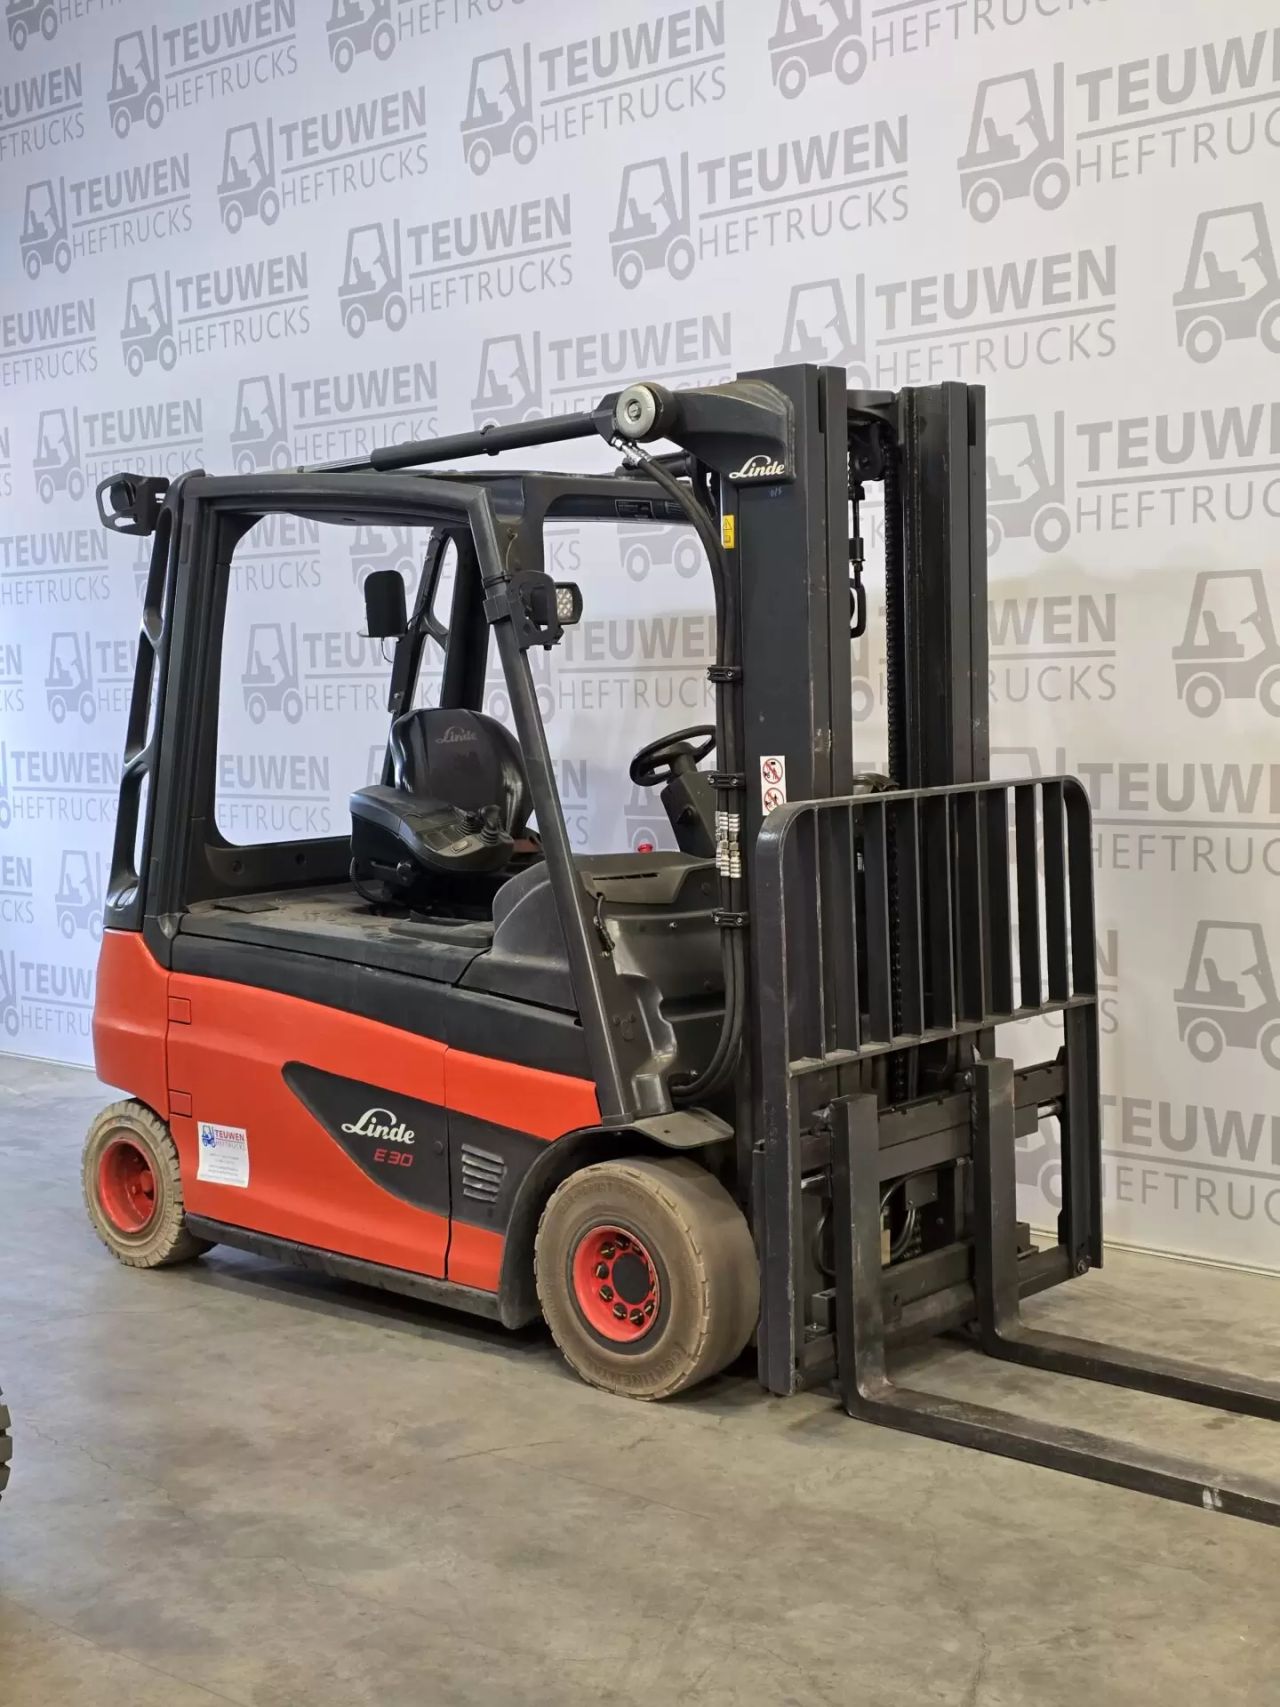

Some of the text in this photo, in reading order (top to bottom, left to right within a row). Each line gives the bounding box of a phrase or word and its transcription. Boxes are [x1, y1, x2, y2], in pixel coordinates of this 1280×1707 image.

[163, 0, 295, 67] TEUWEN
[539, 0, 724, 91] TEUWEN
[872, 0, 1107, 61] HEFTRU
[0, 62, 82, 120] UWEN
[165, 45, 297, 112] HEFTRUCKS
[1076, 27, 1280, 122] TEUW
[279, 86, 426, 162] TEUWEN
[541, 66, 726, 145] HEFTRUCKS
[70, 153, 190, 216] TEUWEN
[282, 144, 428, 209] HEFTRUCKS
[698, 114, 908, 204] TEUWEN
[72, 204, 192, 258] HEFTRUCKS
[407, 193, 571, 265] TEUWEN
[699, 184, 908, 260] HEFTRUCKS
[176, 252, 308, 312] TEUWEN
[409, 254, 573, 314] HEFTRUCKS
[875, 245, 1116, 330] TEUWEN
[0, 297, 96, 347] EUWEN
[178, 305, 310, 356] HEFTRUCKS
[549, 312, 731, 381] TEUWEN
[876, 318, 1116, 388] HEFTRUCKS
[291, 361, 437, 418] TEUWEN
[83, 398, 203, 447] TEUWEN
[729, 455, 785, 479] Linde
[0, 528, 109, 568] TEUWEN
[1, 575, 110, 606] HEFTRUCKS
[561, 615, 717, 662] TEUWE
[11, 751, 119, 784] TEUWEN
[341, 1108, 415, 1144] Linde
